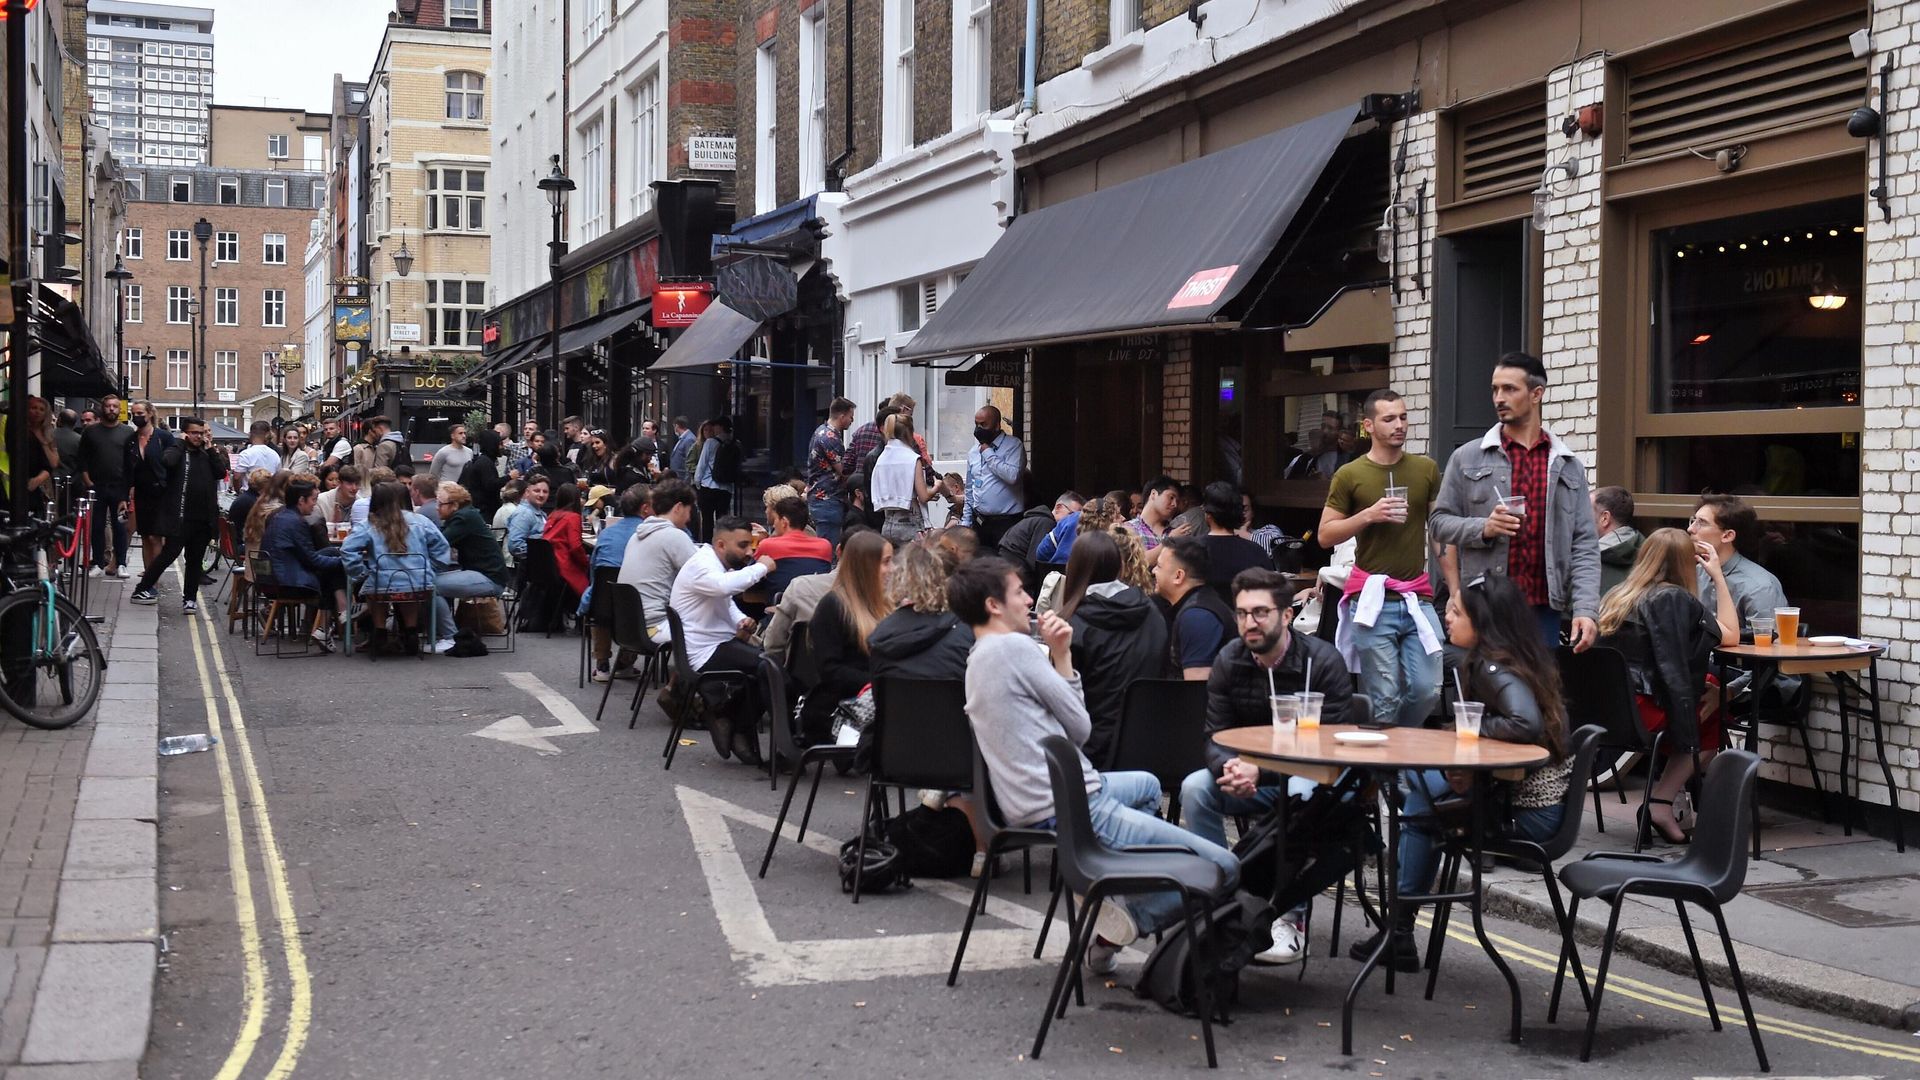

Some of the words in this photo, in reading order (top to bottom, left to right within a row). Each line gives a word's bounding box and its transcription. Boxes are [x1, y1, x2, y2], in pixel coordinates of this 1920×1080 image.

[1181, 276, 1229, 298] THIRST
[1120, 333, 1160, 346] THIRST
[1108, 349, 1132, 361] LIVE
[984, 361, 1021, 372] THIRST
[415, 377, 446, 388] DOG
[974, 373, 1000, 386] LATE
[1003, 375, 1021, 387] BAR
[423, 399, 449, 407] DINING
[322, 405, 340, 413] PIX
